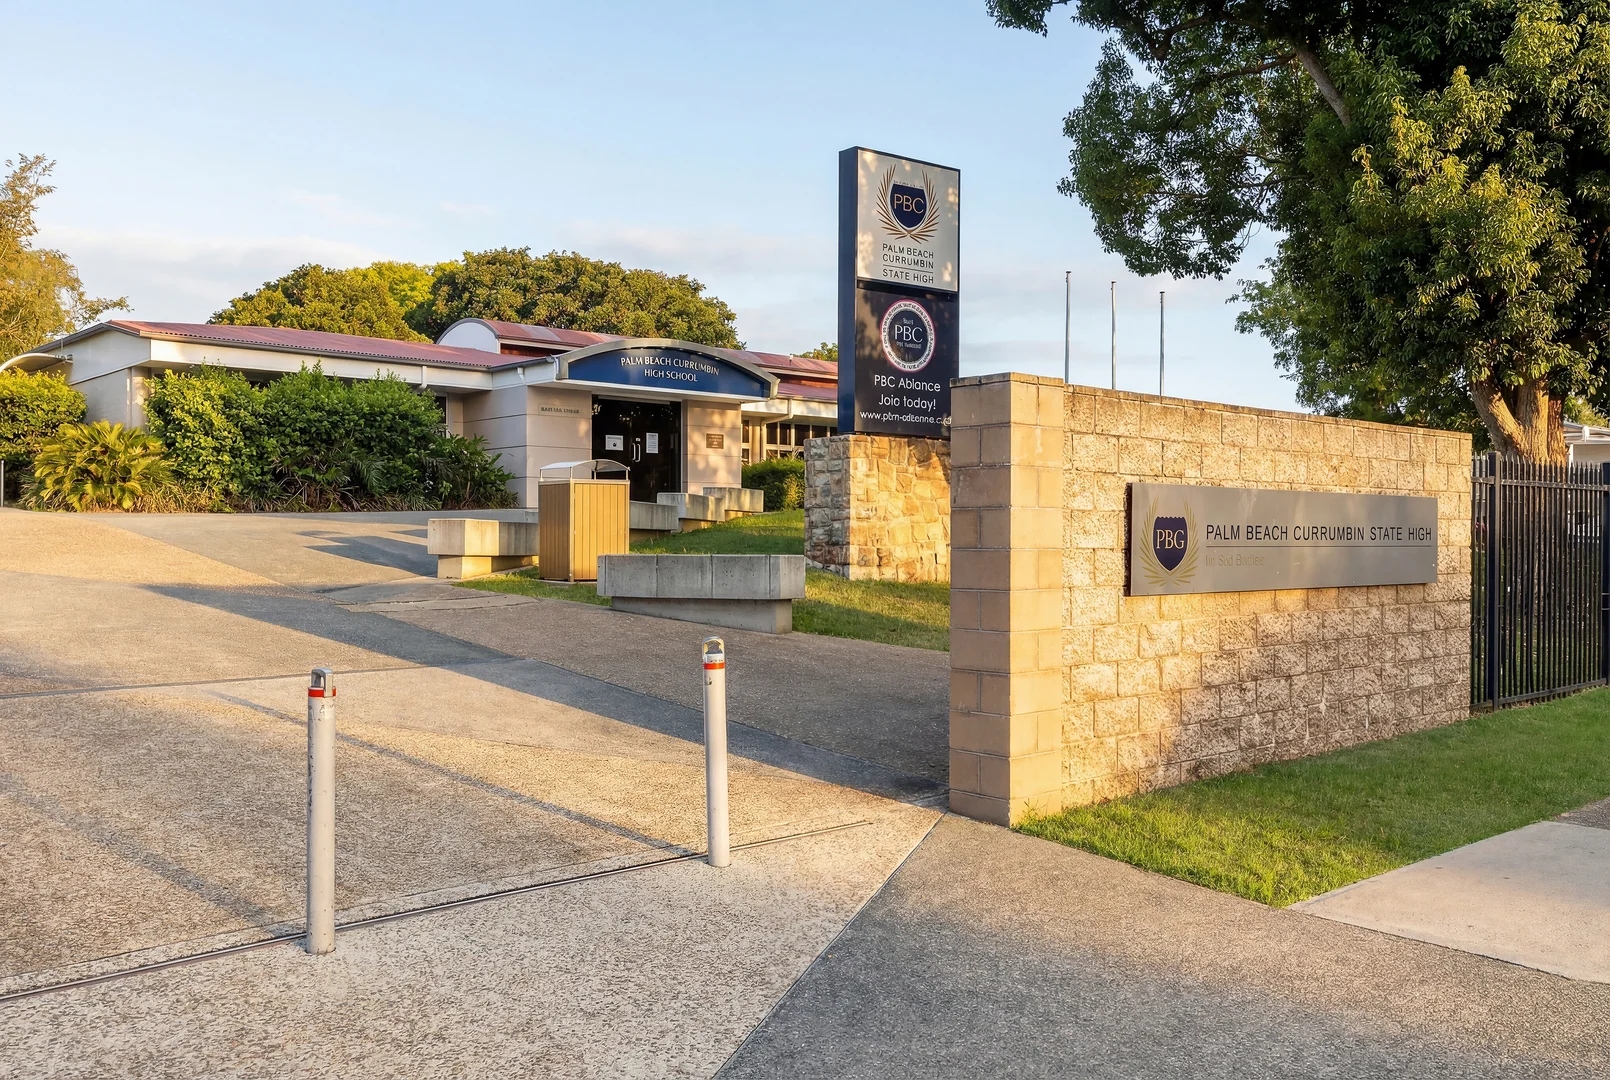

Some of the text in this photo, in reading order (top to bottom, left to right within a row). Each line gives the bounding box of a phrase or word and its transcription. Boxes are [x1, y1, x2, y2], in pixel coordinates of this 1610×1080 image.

[893, 193, 925, 214] PBC
[882, 243, 934, 259] PALM BEACH
[882, 253, 934, 269] CURRUMBIN
[882, 269, 934, 284] STATE HIGH
[894, 324, 923, 343] PBC
[620, 356, 720, 376] PALM BEACH CURRUMBIN
[644, 369, 698, 382] HIGH SCHOOL
[874, 374, 896, 388] PBC
[1206, 524, 1432, 541] PALM BEACH CURRUMBIN STATE HIGH
